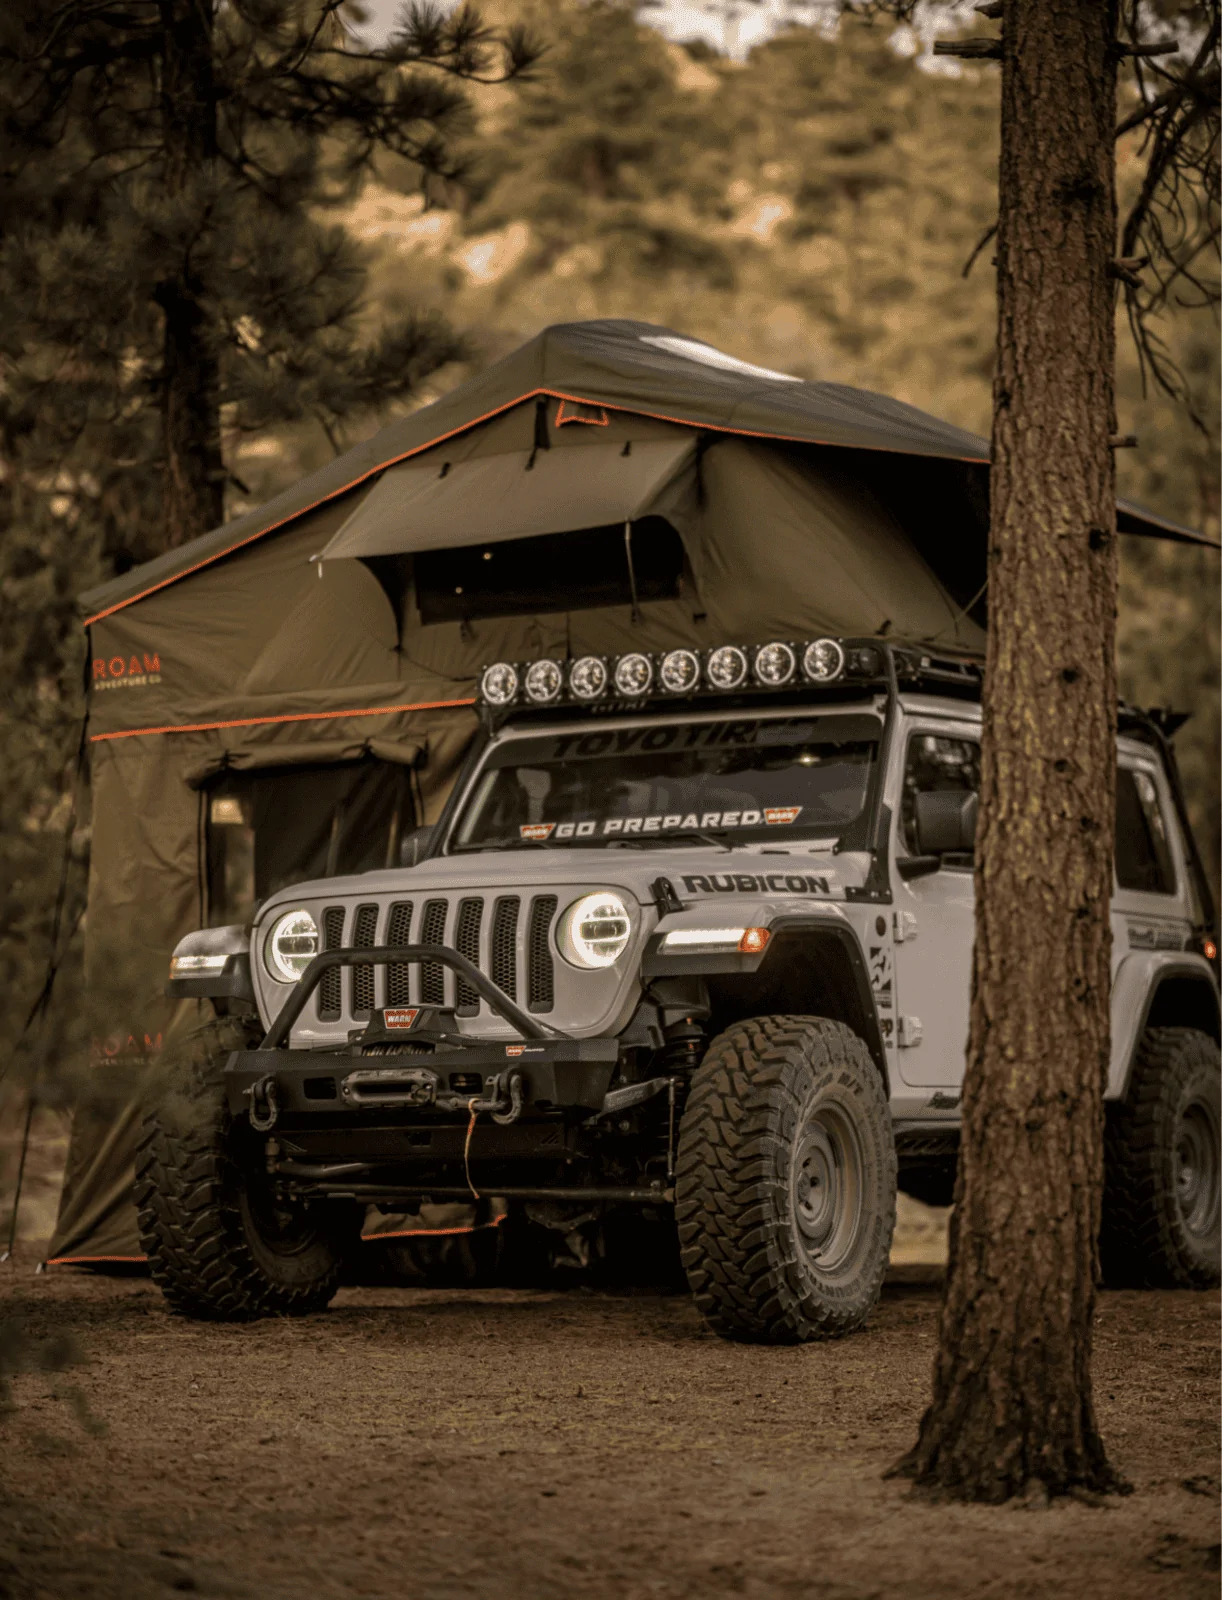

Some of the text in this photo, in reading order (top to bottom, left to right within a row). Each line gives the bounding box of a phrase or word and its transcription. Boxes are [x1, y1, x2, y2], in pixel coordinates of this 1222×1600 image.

[92, 653, 160, 679] ROAM
[555, 821, 597, 838] GO
[681, 874, 831, 894] RUBICON
